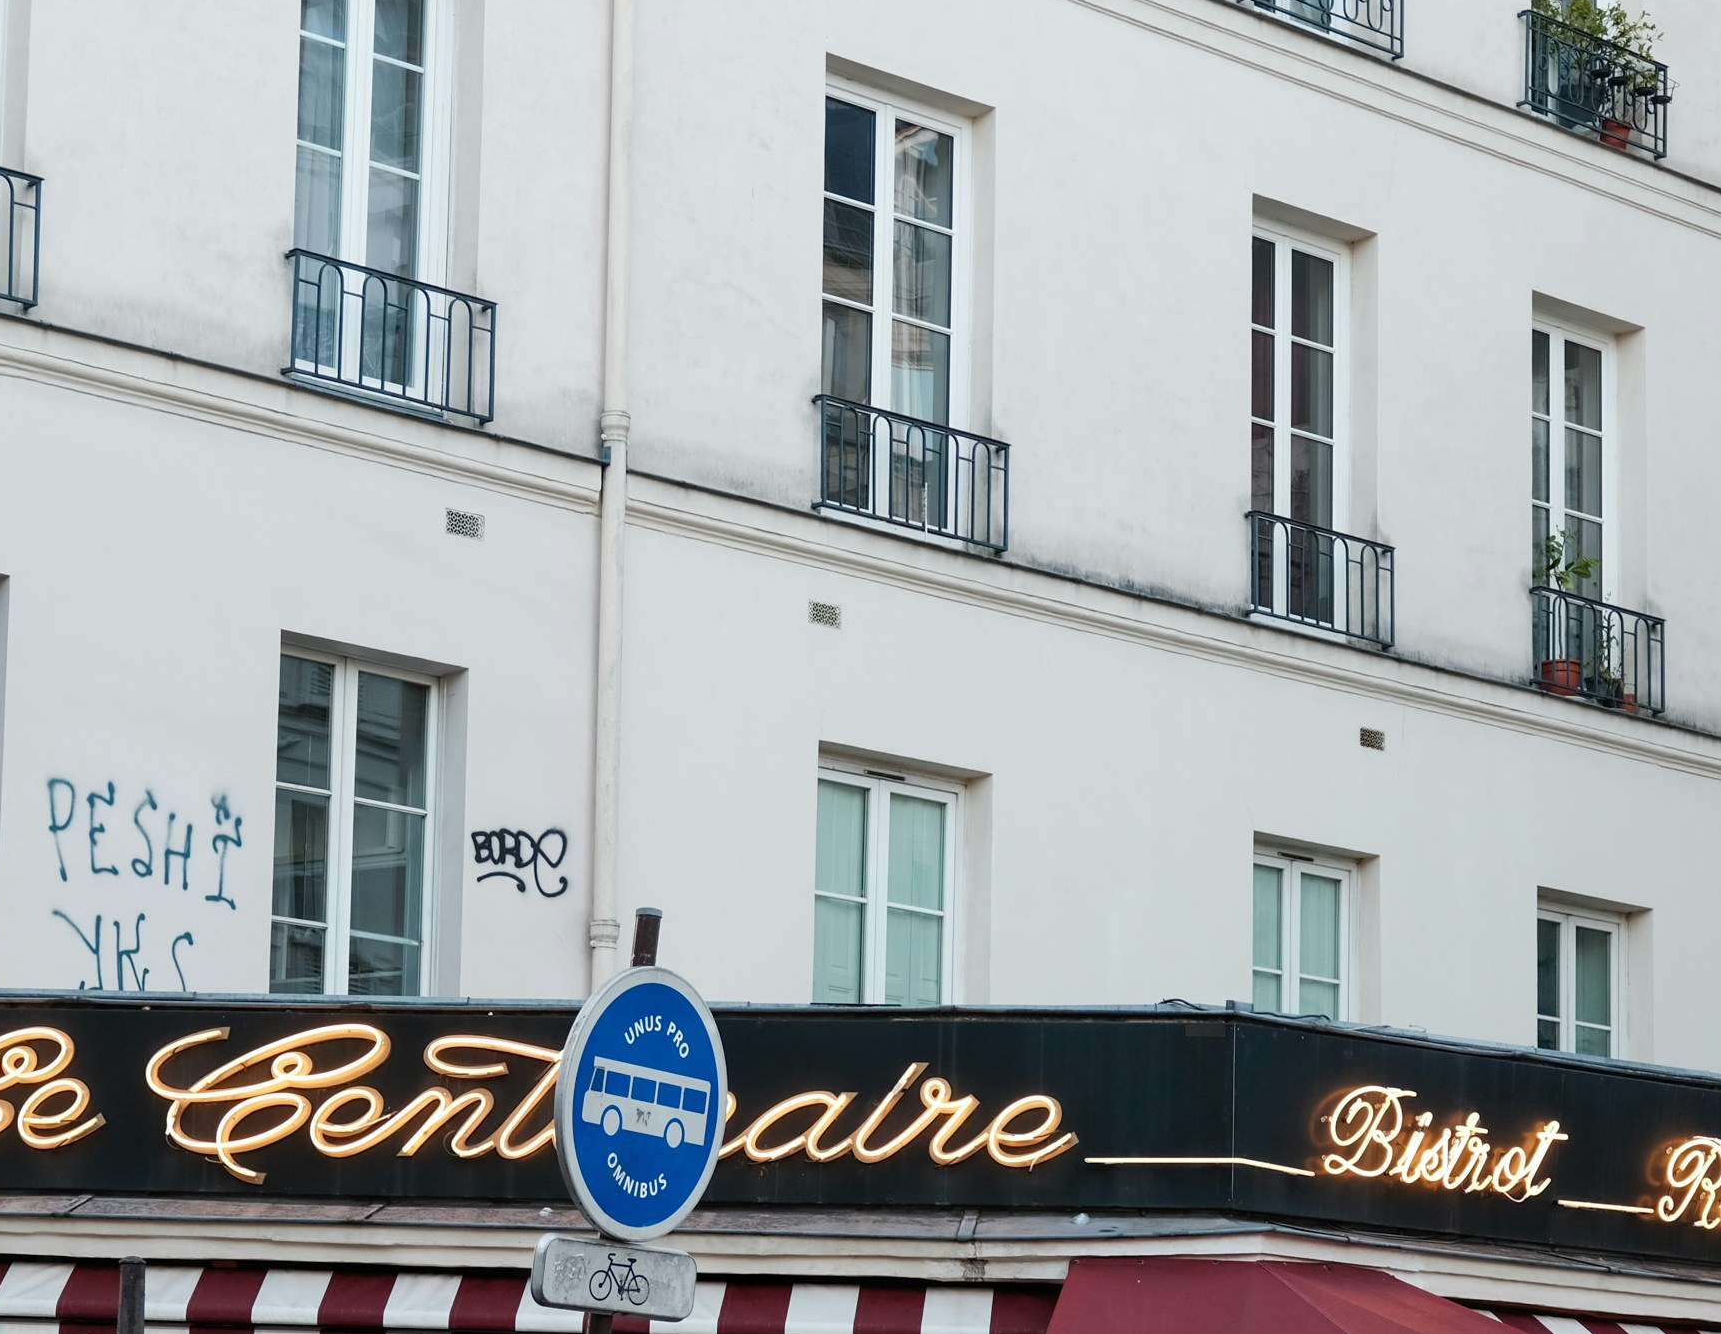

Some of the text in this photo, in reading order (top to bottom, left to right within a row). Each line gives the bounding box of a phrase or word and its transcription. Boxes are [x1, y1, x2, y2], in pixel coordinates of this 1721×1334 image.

[623, 1014, 691, 1060] UNUS PRO
[143, 1021, 1080, 1185] Centaire
[1323, 1084, 1569, 1203] Bistrot
[606, 1150, 669, 1201] OMNIBUS
